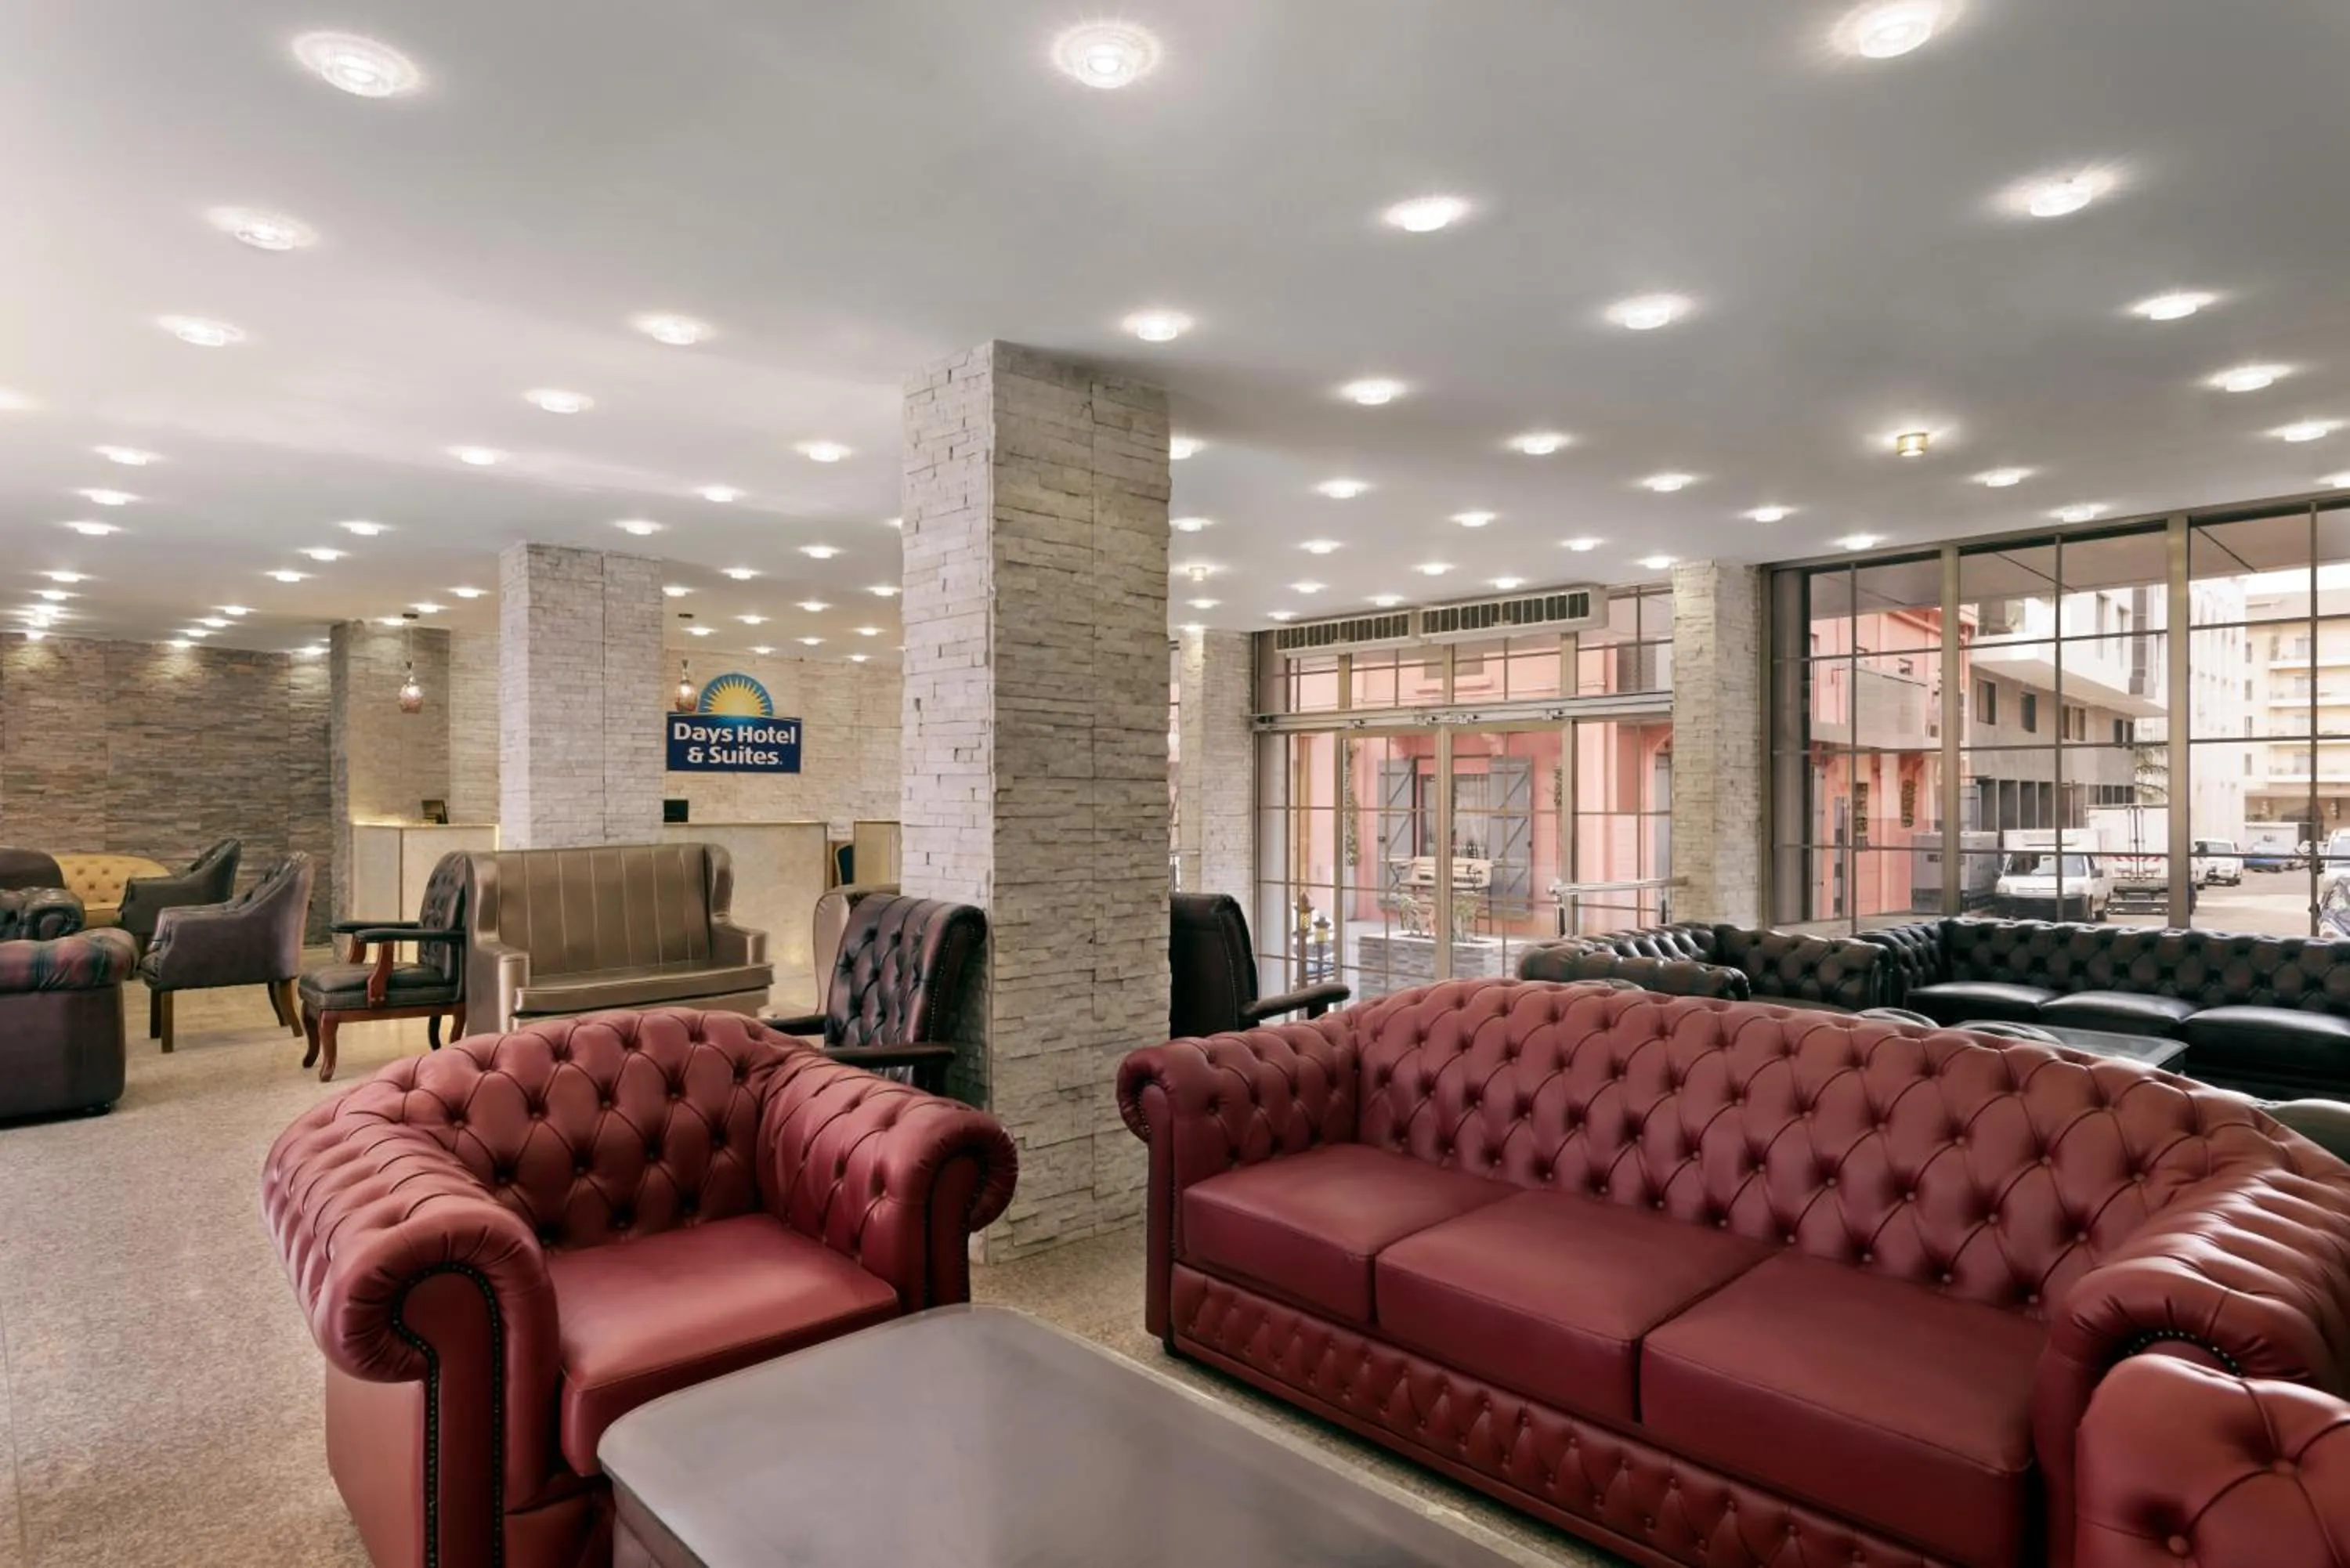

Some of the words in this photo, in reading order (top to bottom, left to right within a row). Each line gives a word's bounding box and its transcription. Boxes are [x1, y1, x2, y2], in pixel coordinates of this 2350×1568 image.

[674, 722, 733, 744] Days
[737, 725, 796, 744] Hotel
[687, 746, 704, 764] &
